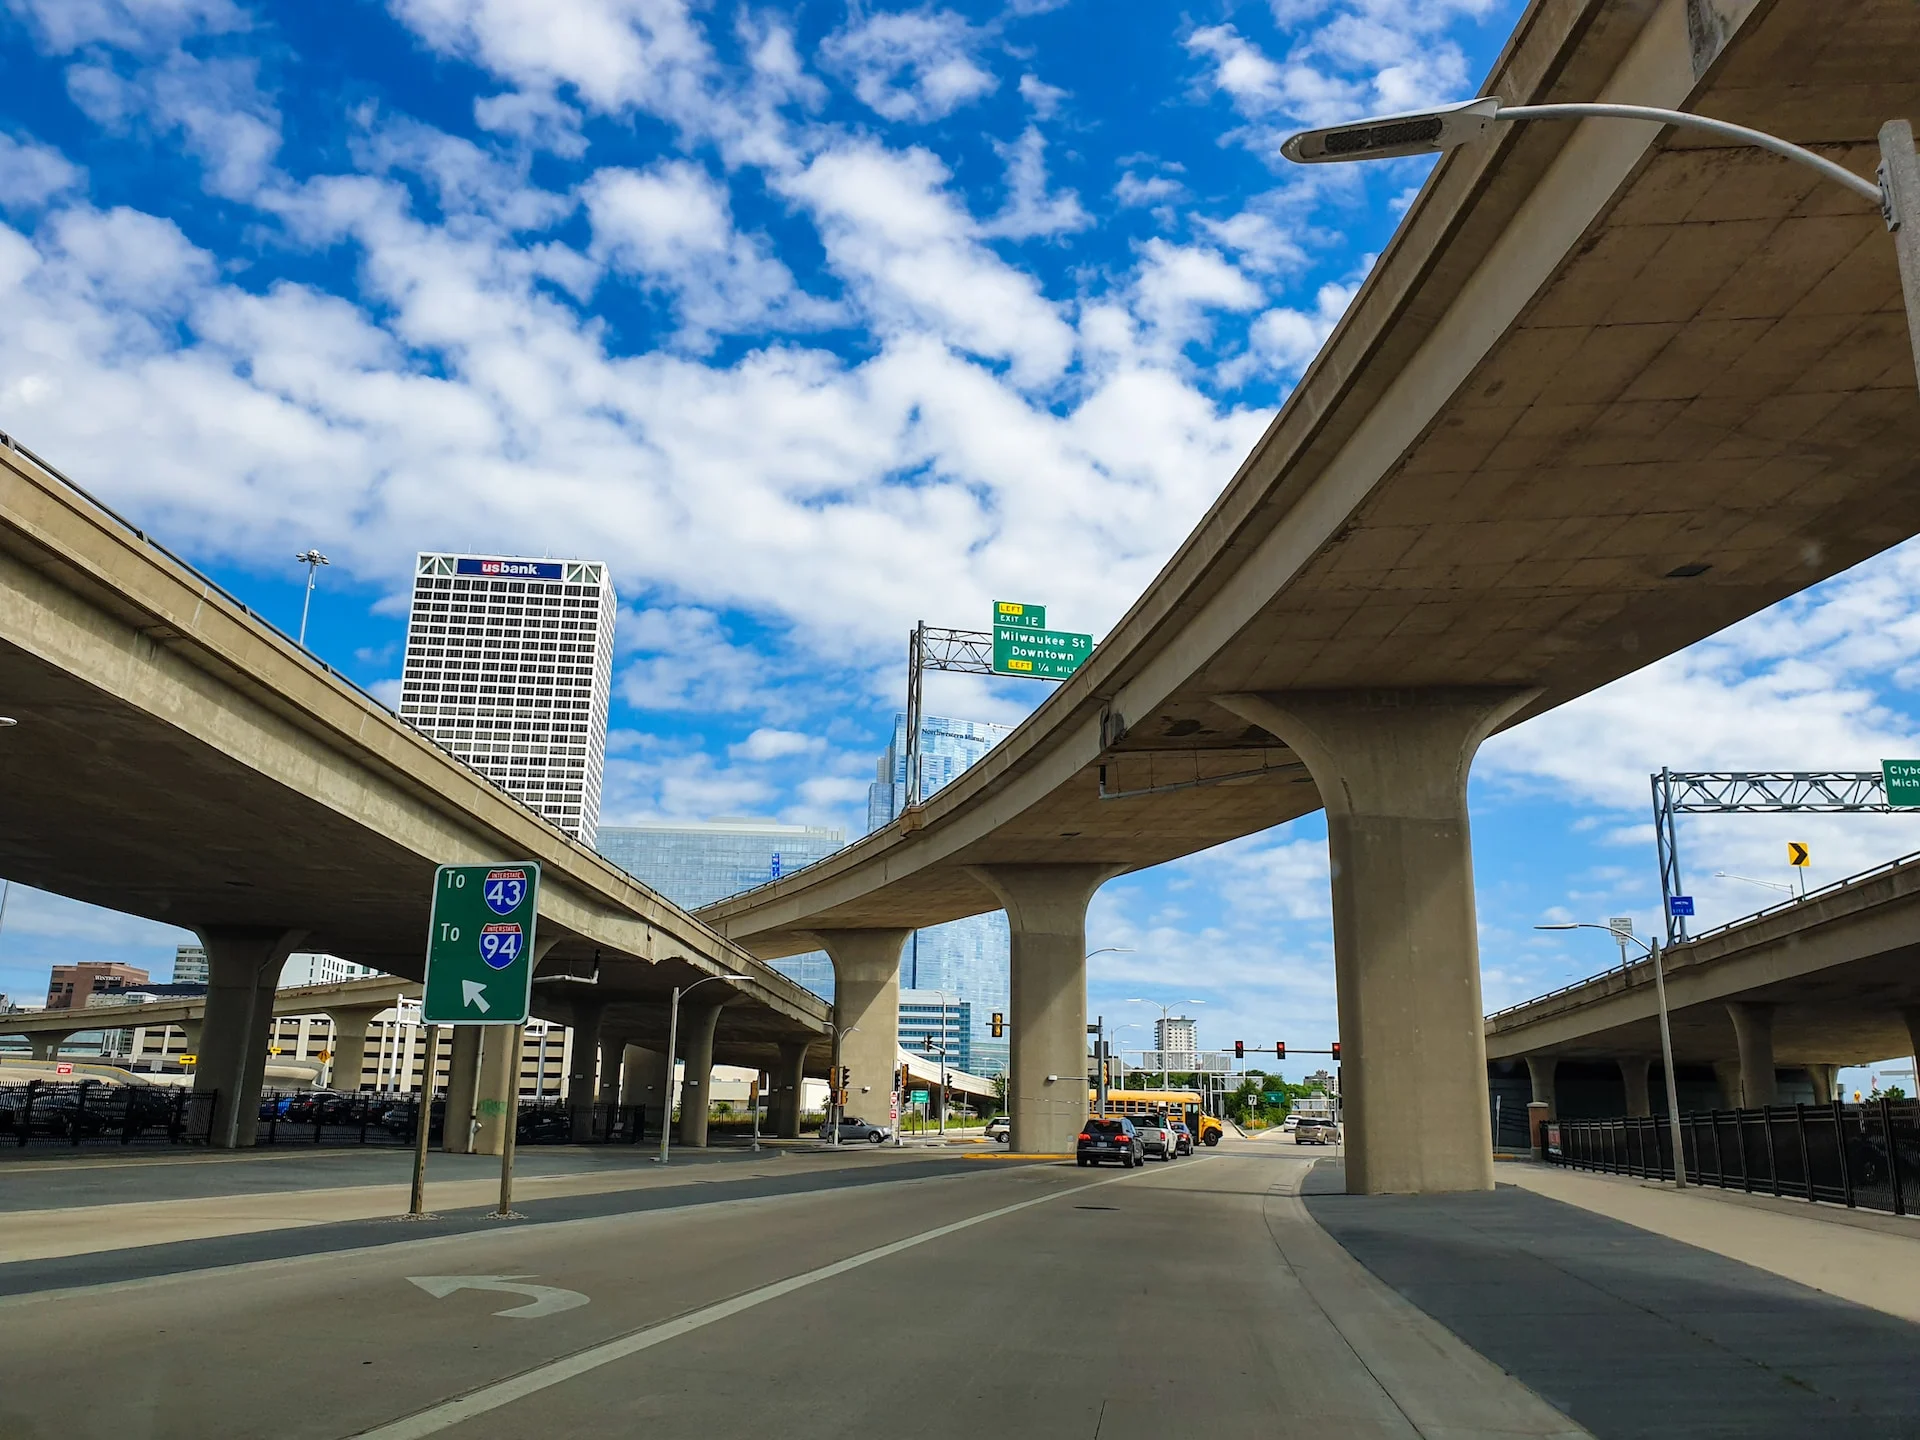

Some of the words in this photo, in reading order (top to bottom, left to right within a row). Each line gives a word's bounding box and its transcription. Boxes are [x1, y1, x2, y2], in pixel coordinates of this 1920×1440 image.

[482, 562, 538, 575] usbank
[1000, 604, 1021, 613] LEFT
[1000, 615, 1019, 623] EXIT
[1025, 616, 1038, 626] 1E
[1001, 630, 1065, 646] Milwaukee
[1072, 638, 1085, 648] St
[1012, 646, 1074, 661] Downtown
[1010, 661, 1030, 670] LEFT
[921, 728, 964, 739] Northwestern
[965, 734, 984, 742] Mutual
[1891, 778, 1920, 787] Mich
[446, 870, 465, 889] To
[491, 871, 520, 879] INTERSTATE
[487, 881, 521, 906] 43
[441, 923, 460, 942] To
[483, 934, 517, 960] 94
